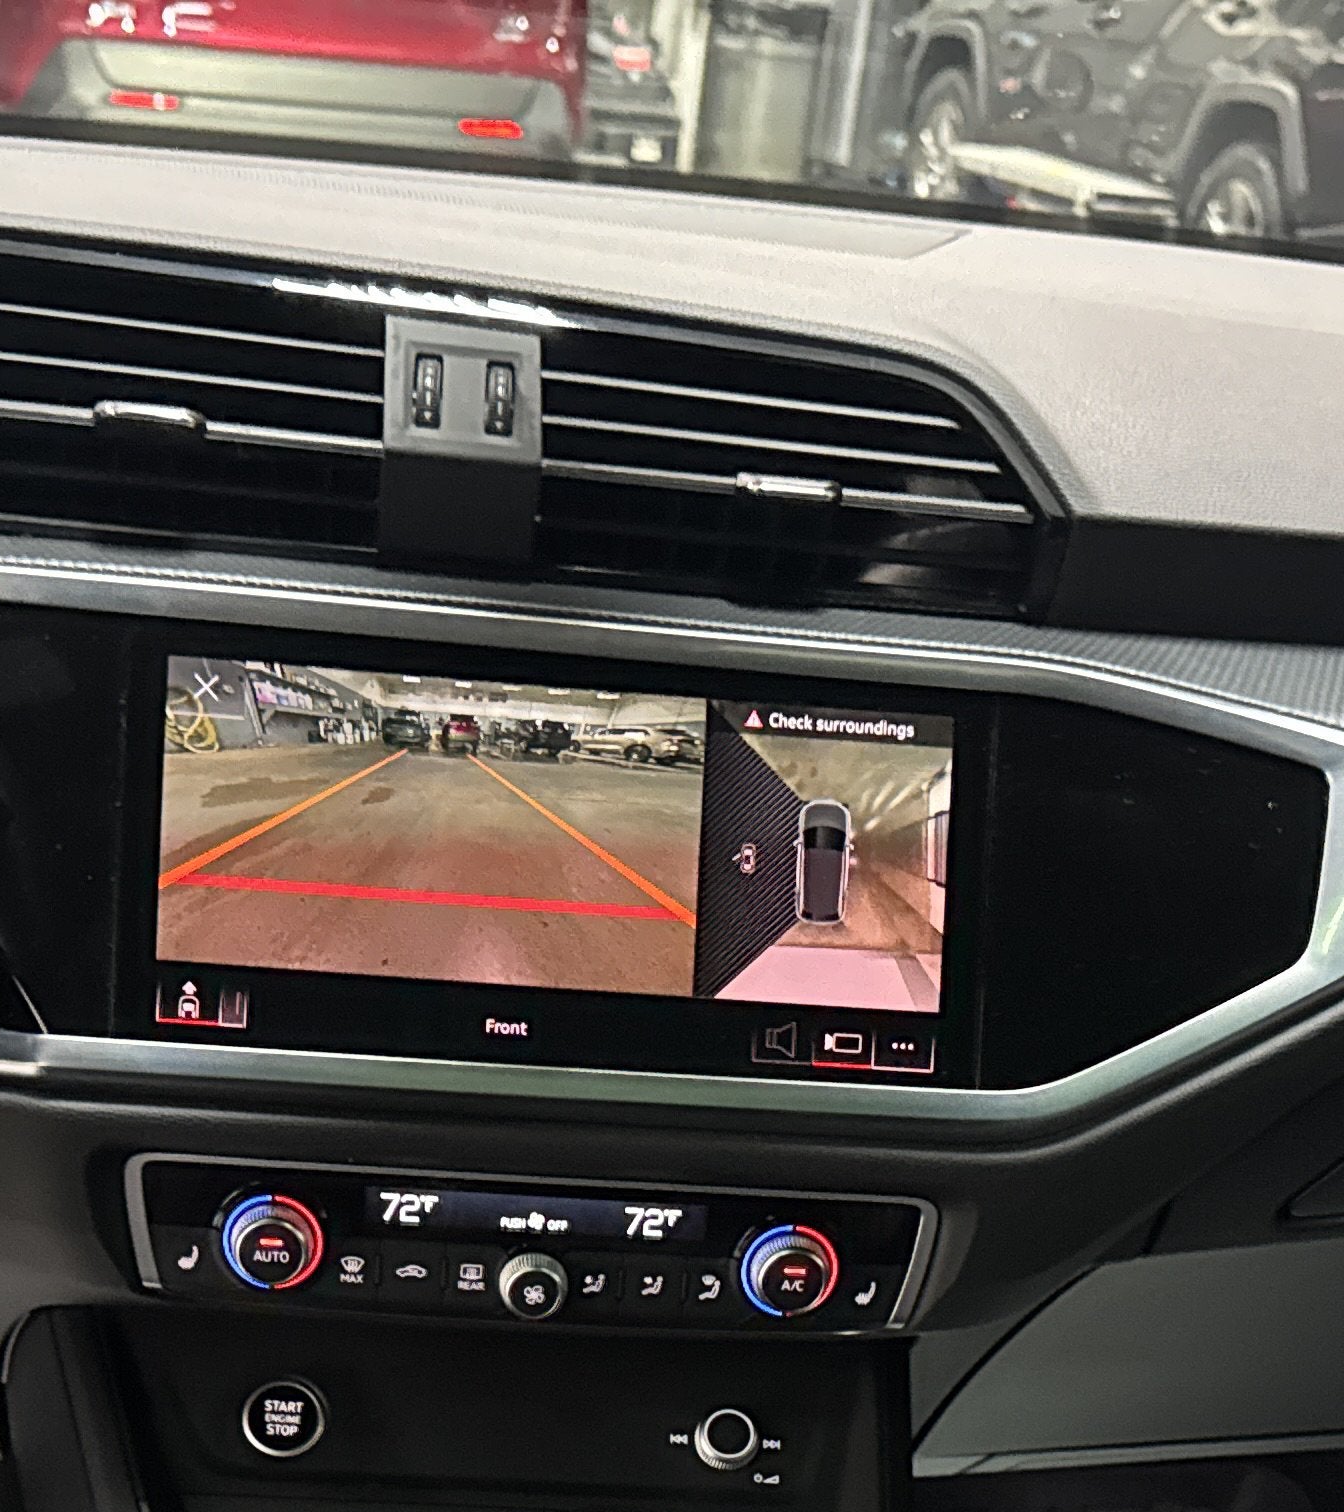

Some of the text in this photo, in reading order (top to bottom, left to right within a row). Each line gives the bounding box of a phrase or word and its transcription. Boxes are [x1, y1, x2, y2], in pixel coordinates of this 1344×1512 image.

[768, 711, 915, 741] Check surroundings
[485, 1018, 528, 1036] Front
[500, 1216, 568, 1231] PUSH OFF
[254, 1250, 290, 1263] AUTO
[340, 1273, 364, 1284] MAX
[457, 1281, 485, 1291] REAR
[781, 1280, 805, 1292] A/C
[264, 1400, 304, 1413] START
[264, 1412, 302, 1425] ENGINE
[266, 1423, 299, 1437] STOP
